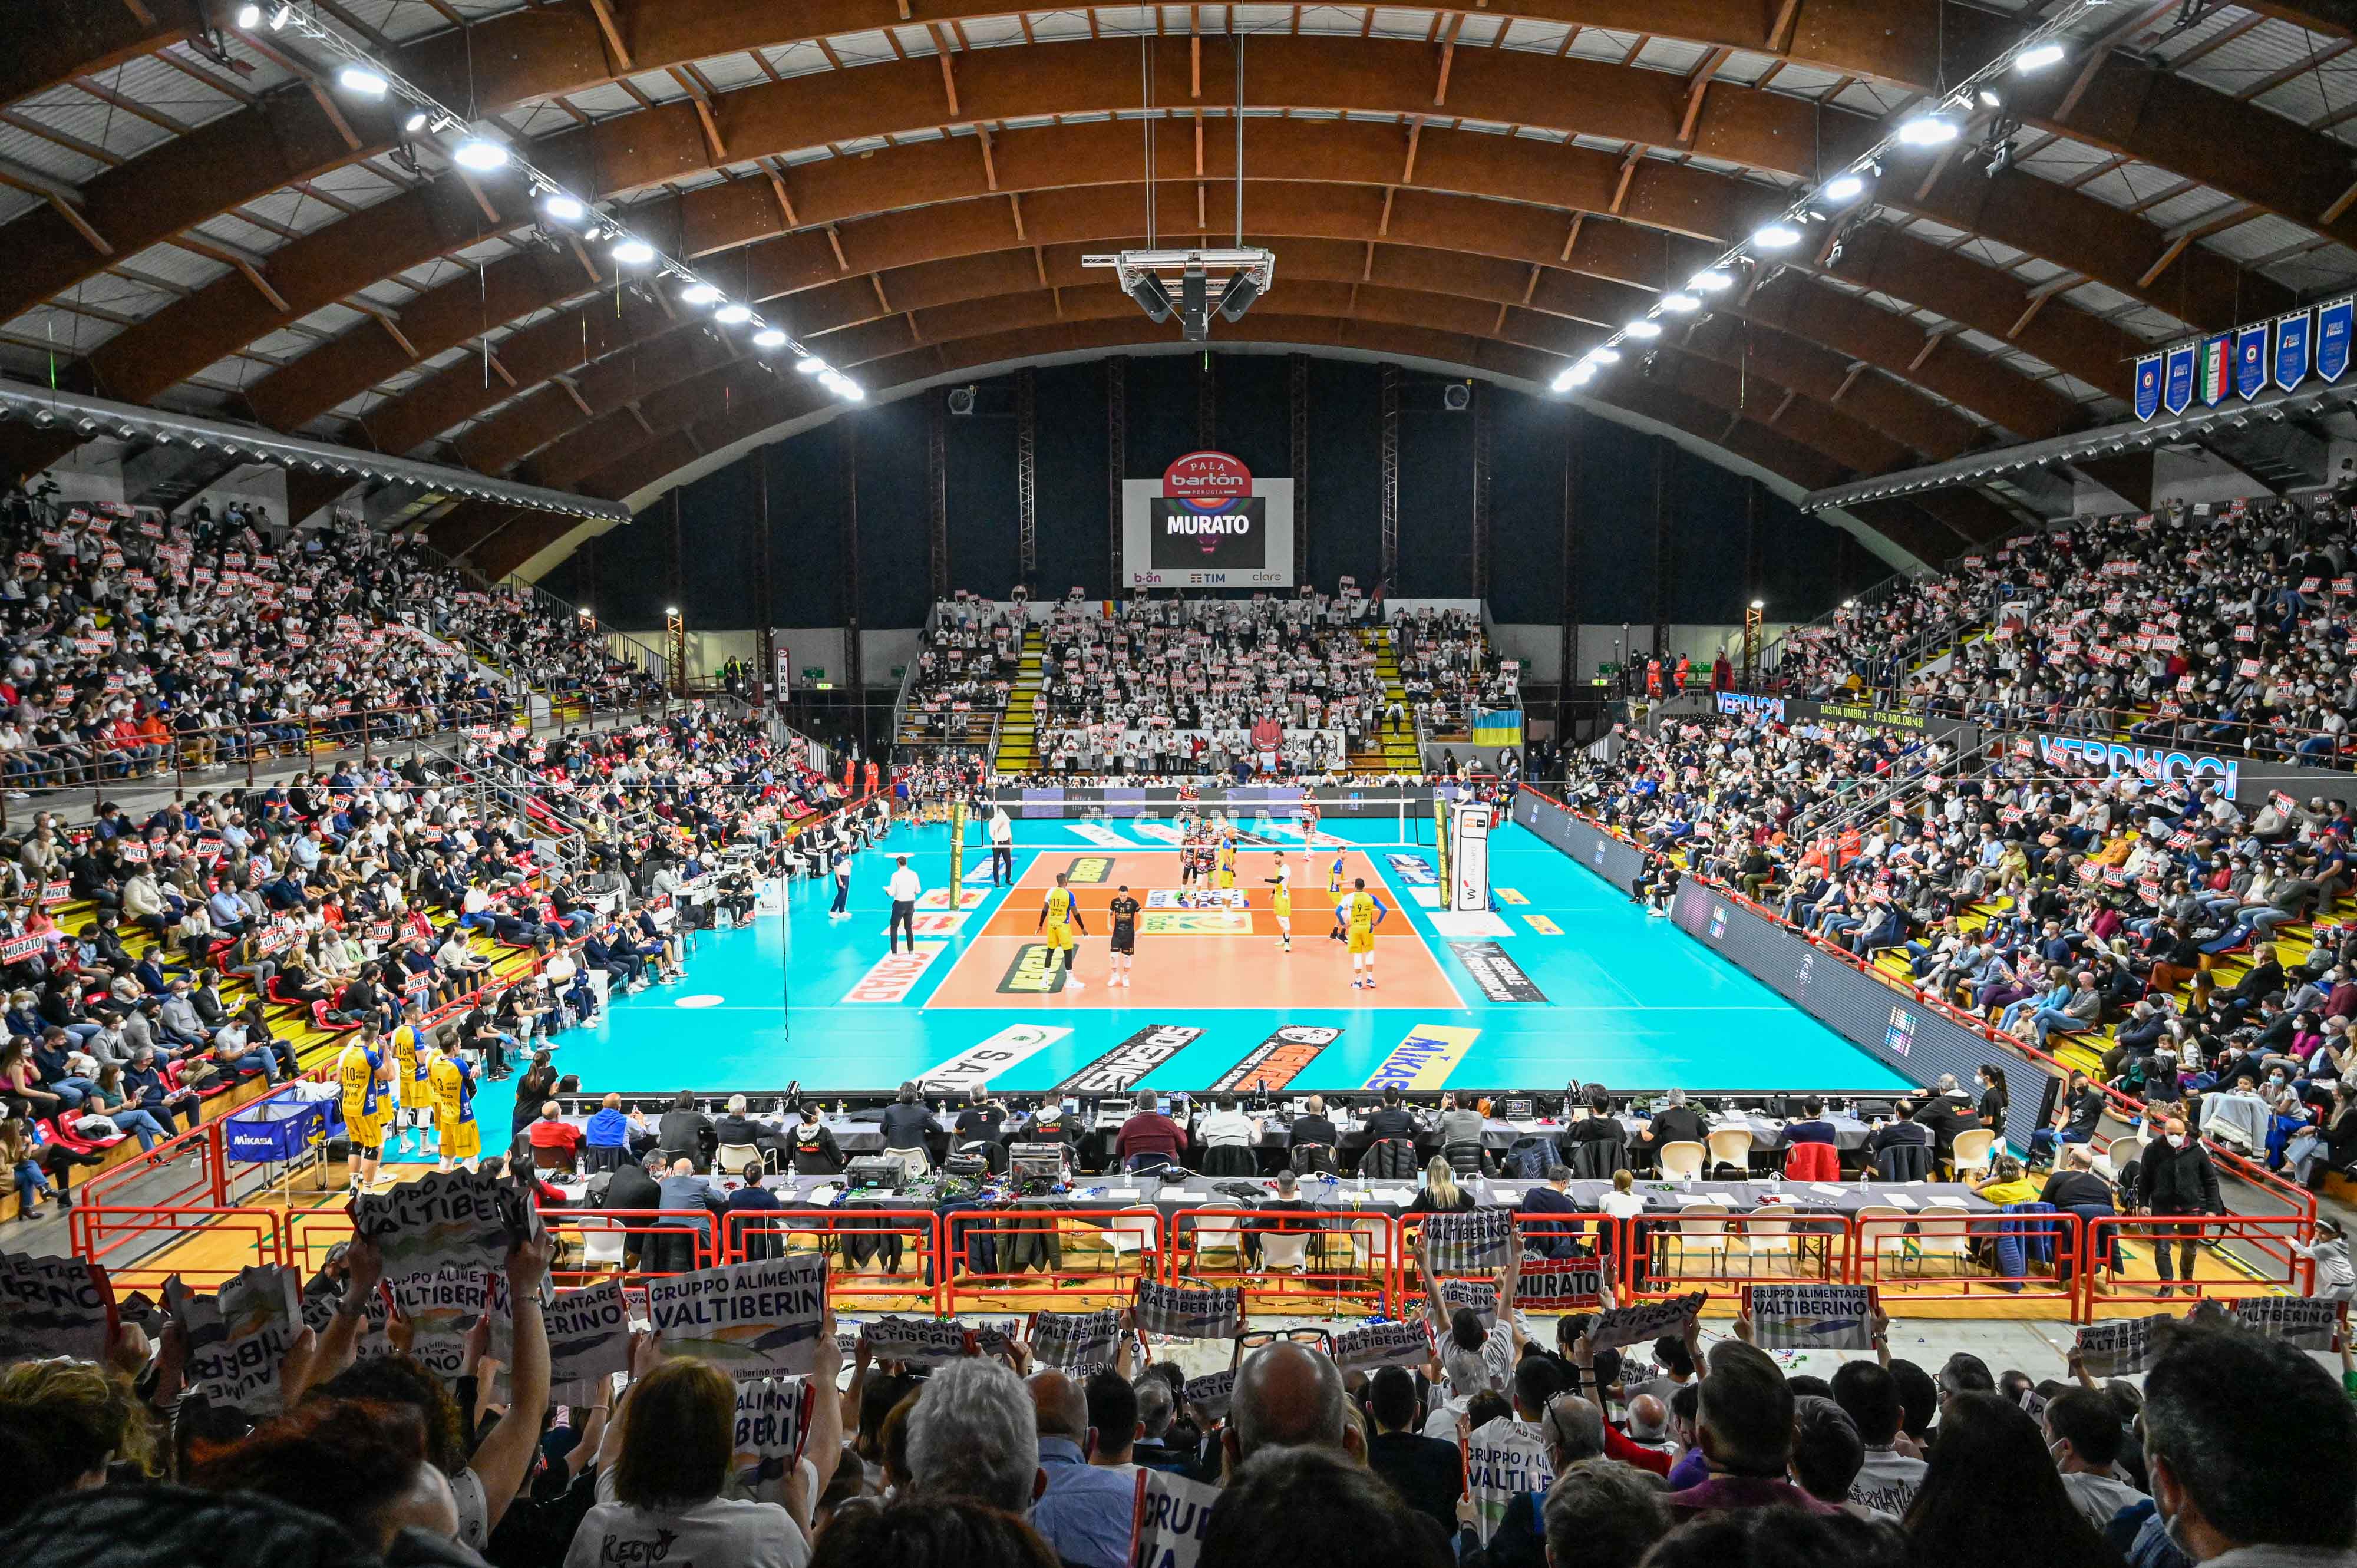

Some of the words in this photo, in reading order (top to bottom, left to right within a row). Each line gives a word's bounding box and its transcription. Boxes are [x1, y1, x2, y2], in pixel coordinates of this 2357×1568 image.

[1190, 461, 1225, 471] PALA
[1167, 515, 1249, 534] MURATO
[1204, 573, 1226, 583] TIM
[1820, 705, 1842, 717] BASTIA
[1844, 708, 1867, 720] UMBRA
[1053, 899, 1061, 908] 17
[1358, 904, 1362, 913] 9
[4, 939, 41, 957] MURATO
[850, 952, 927, 1000] CONAD
[398, 1046, 407, 1057] 16
[345, 1067, 355, 1081] 10
[234, 1134, 273, 1145] MIKASA
[1427, 1218, 1458, 1227] GRUPPO
[1462, 1213, 1510, 1226] ALIMENTARE
[1427, 1224, 1511, 1240] VALTIBERINO
[651, 1278, 729, 1302] GRUPPO
[1141, 1281, 1177, 1298] GRUPPO
[1178, 1290, 1237, 1303] ALIMENTARE
[1517, 1272, 1599, 1297] MURATO
[1753, 1289, 1795, 1299] GRUPPO
[1797, 1289, 1867, 1299] ALIMENTARE
[653, 1288, 823, 1329] VALTIBERIN
[1141, 1292, 1236, 1313] VALTIBERINO
[1754, 1300, 1867, 1315] VALTIBERINO
[1038, 1313, 1074, 1328] GRUPPO
[1036, 1324, 1118, 1341] VALTIBERINO
[1337, 1331, 1427, 1355] VALTIBERINO
